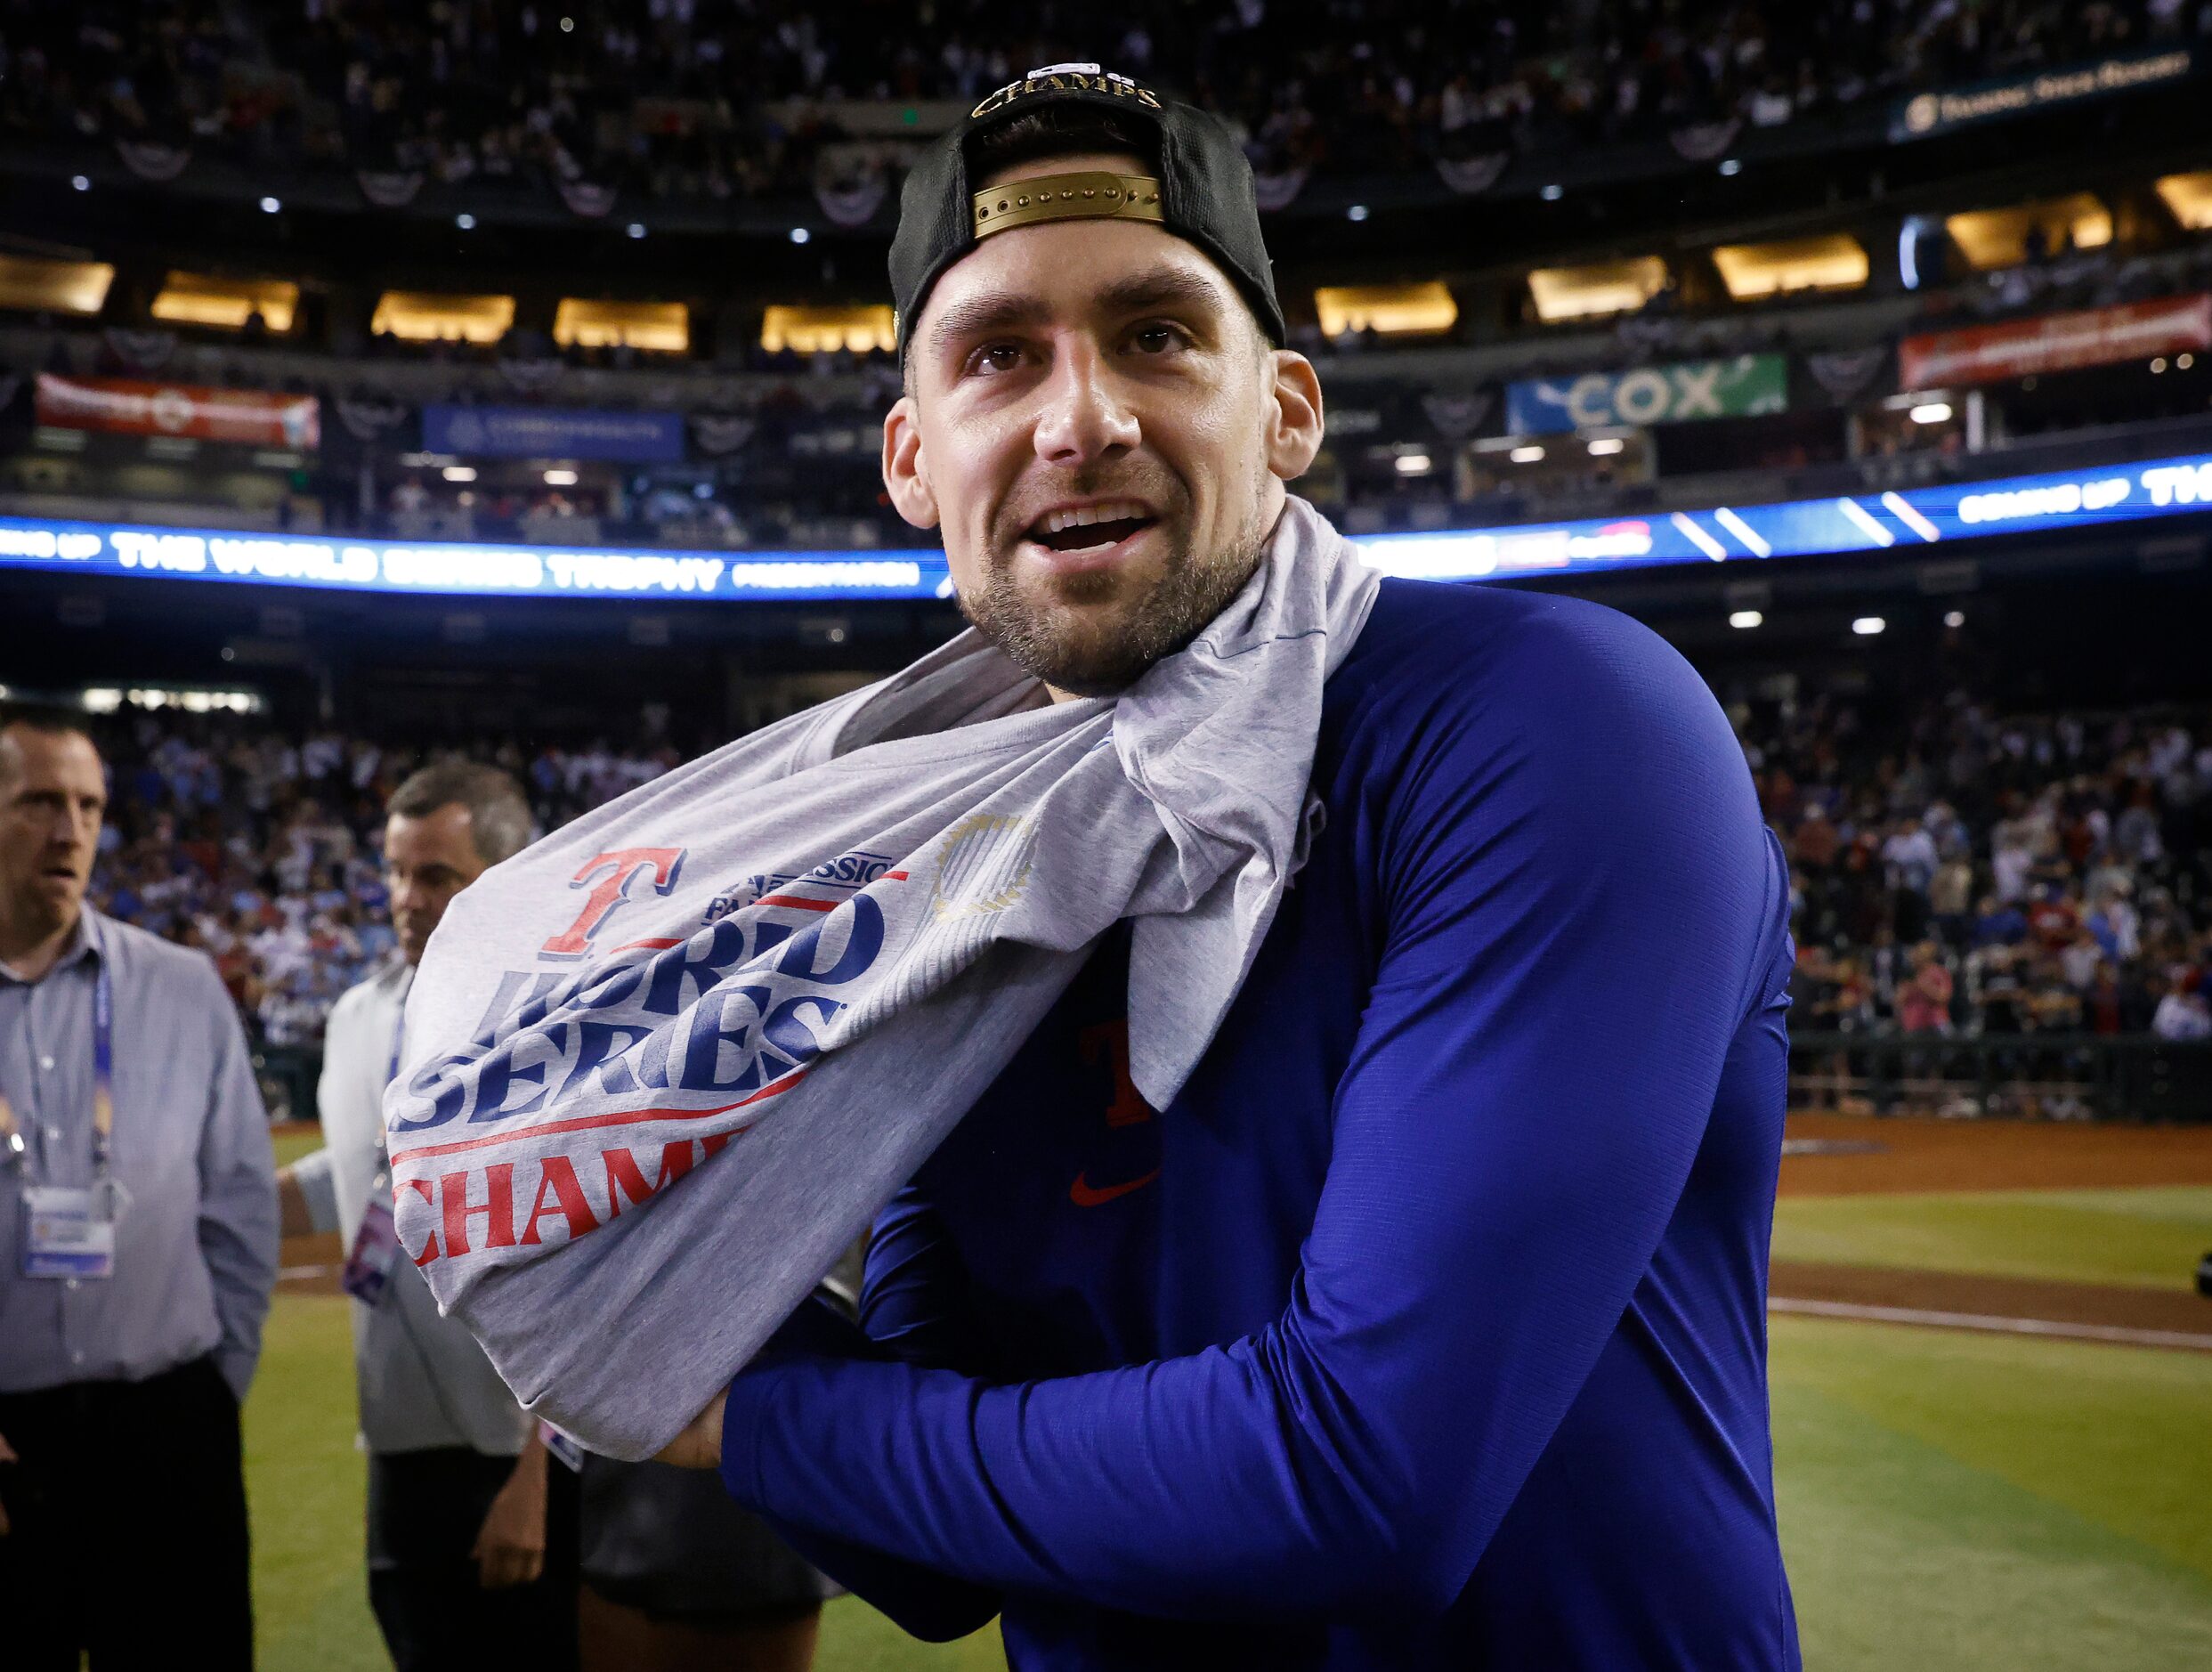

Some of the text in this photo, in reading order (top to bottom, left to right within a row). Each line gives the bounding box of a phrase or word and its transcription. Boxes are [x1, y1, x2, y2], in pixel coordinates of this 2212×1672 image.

[971, 72, 1162, 118] CHAMPS
[1567, 361, 1724, 427] COX
[110, 532, 207, 572] THE
[208, 539, 378, 583] WORLD
[538, 848, 689, 962] T
[386, 985, 847, 1132] SERIES
